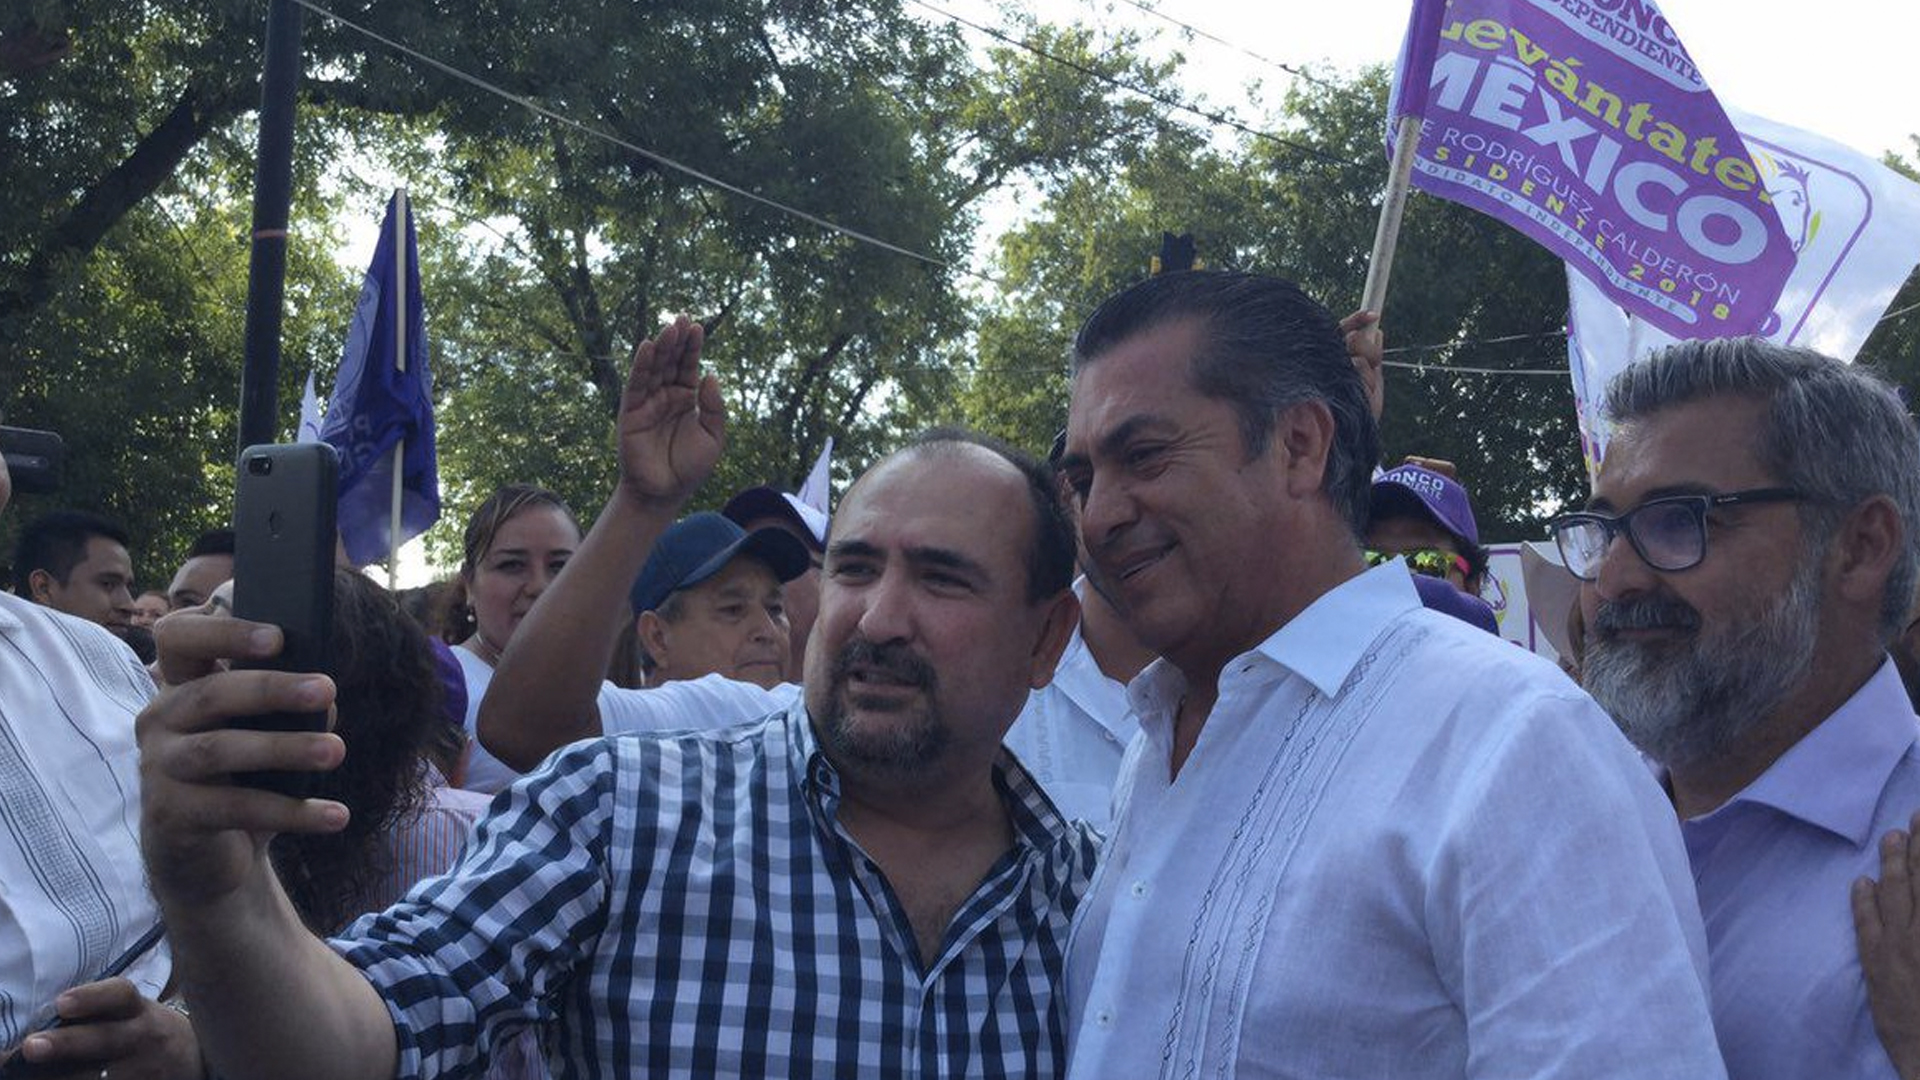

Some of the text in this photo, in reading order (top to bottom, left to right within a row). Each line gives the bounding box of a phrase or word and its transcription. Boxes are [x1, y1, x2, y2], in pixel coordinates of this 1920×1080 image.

[1551, 0, 1702, 85] EPENDIENTE
[1434, 146, 1730, 320] SIDENTE 2018
[1442, 127, 1594, 221] RODRÍGUEZ
[1598, 219, 1741, 305] CALDERÓN
